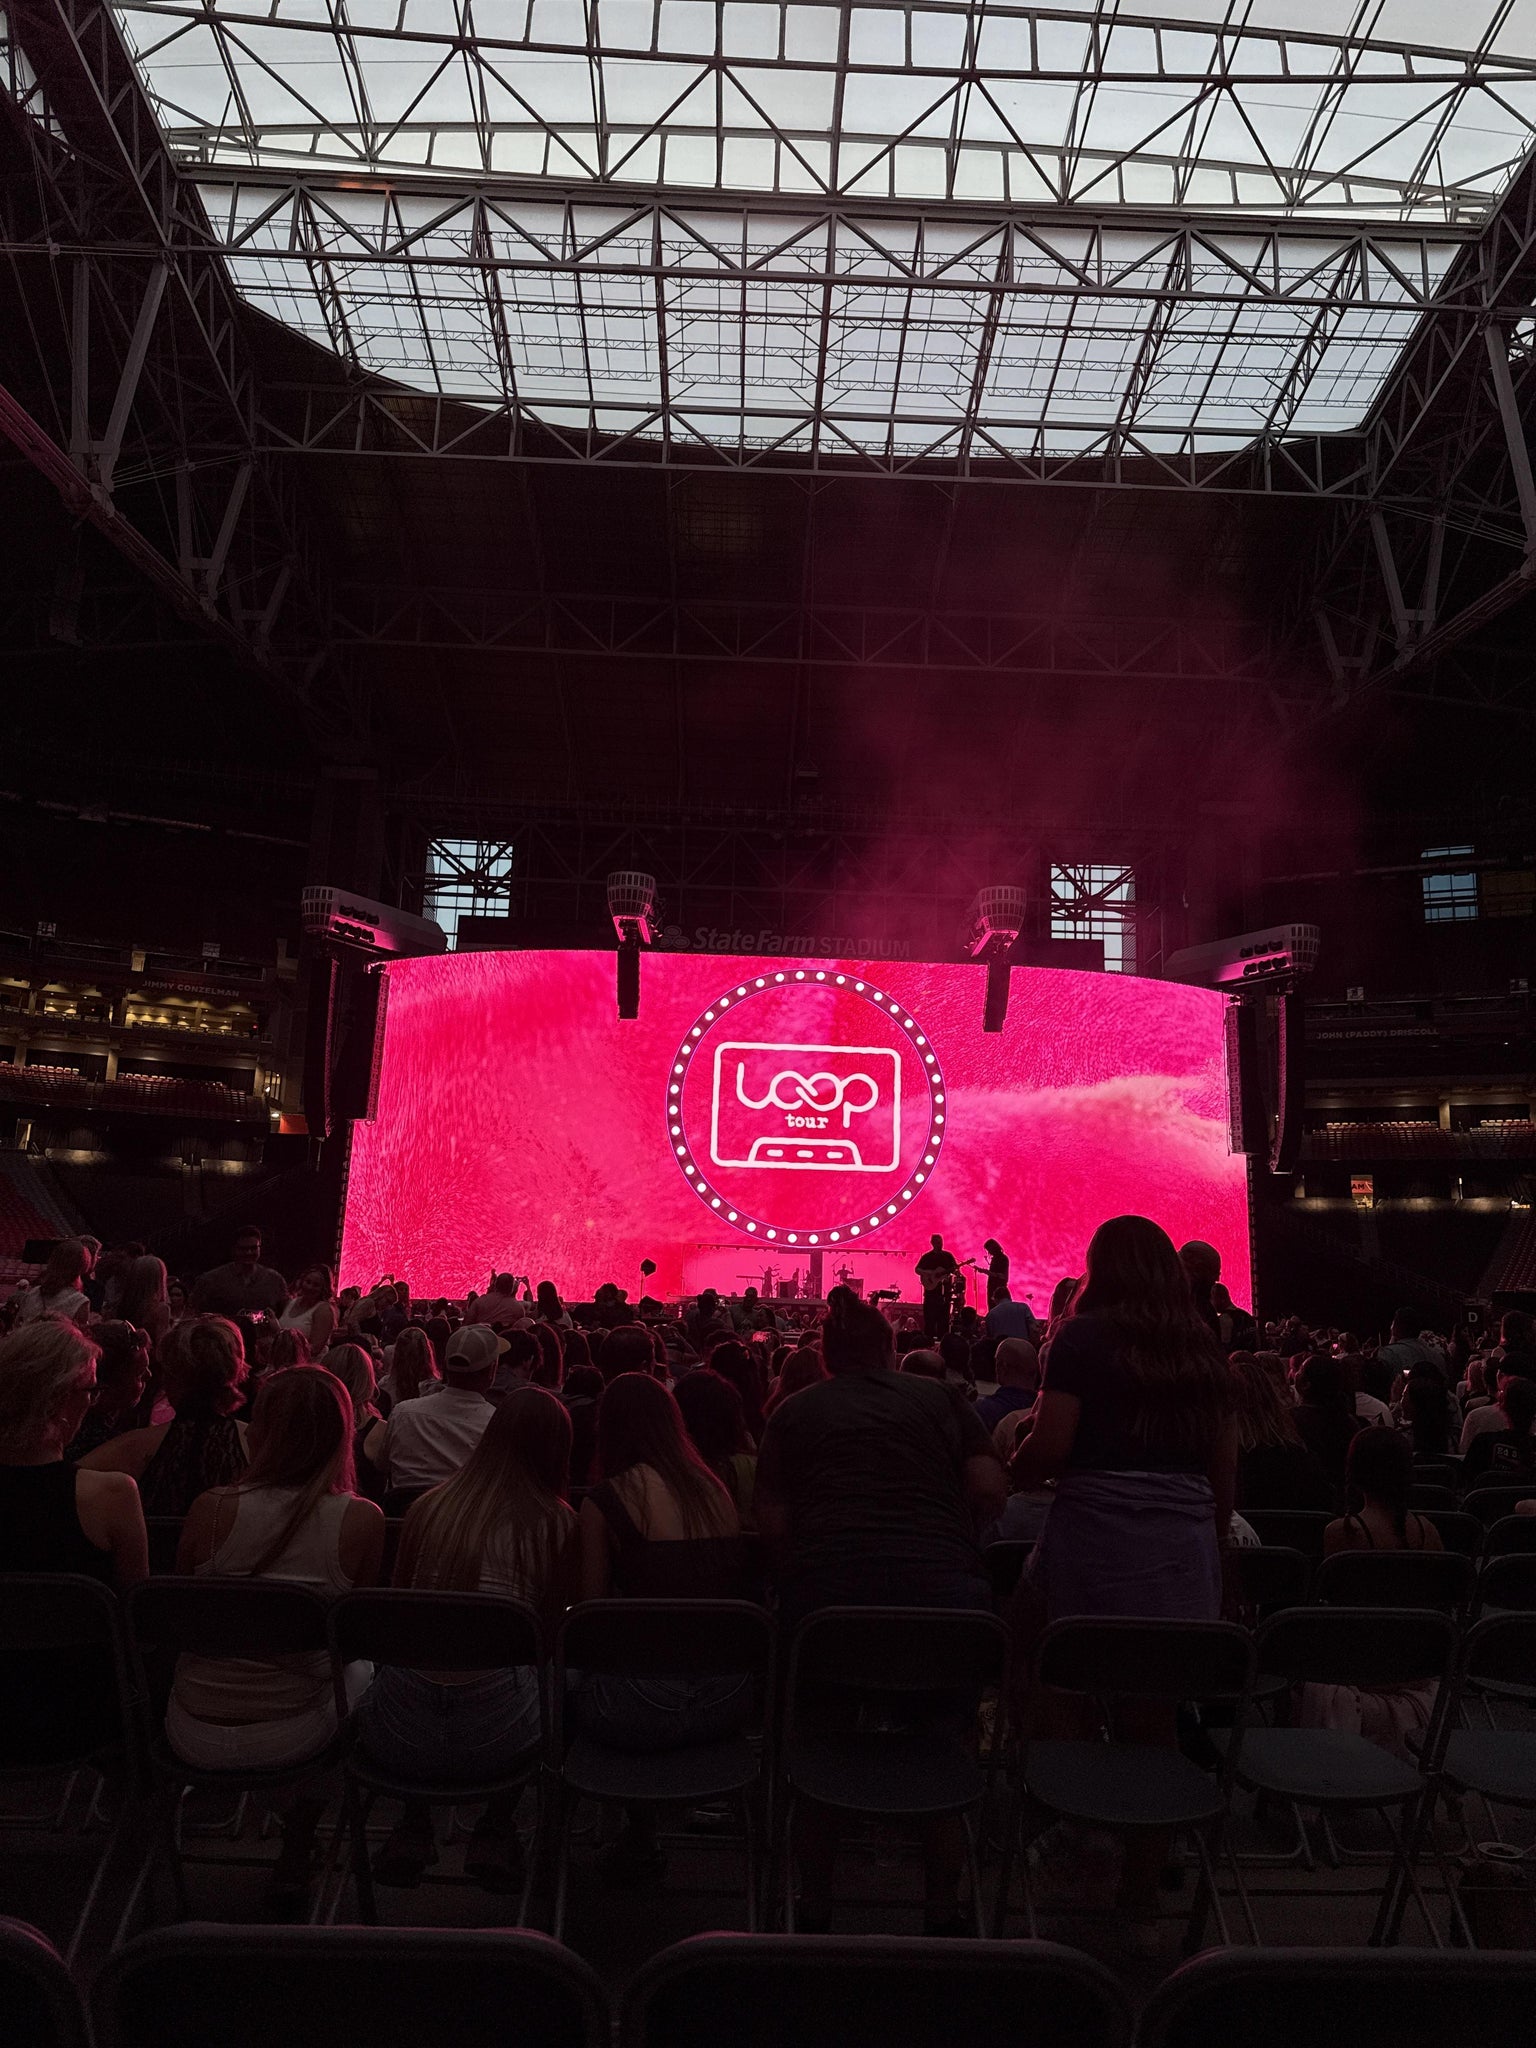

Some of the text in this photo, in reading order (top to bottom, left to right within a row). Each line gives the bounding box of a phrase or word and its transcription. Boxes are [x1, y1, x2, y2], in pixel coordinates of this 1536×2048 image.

[819, 936, 911, 957] STADIUM
[142, 980, 241, 998] JIMMY CONZELMAN
[1315, 1031, 1343, 1040] JOHN
[784, 1113, 829, 1129] tour
[1467, 1311, 1478, 1323] D
